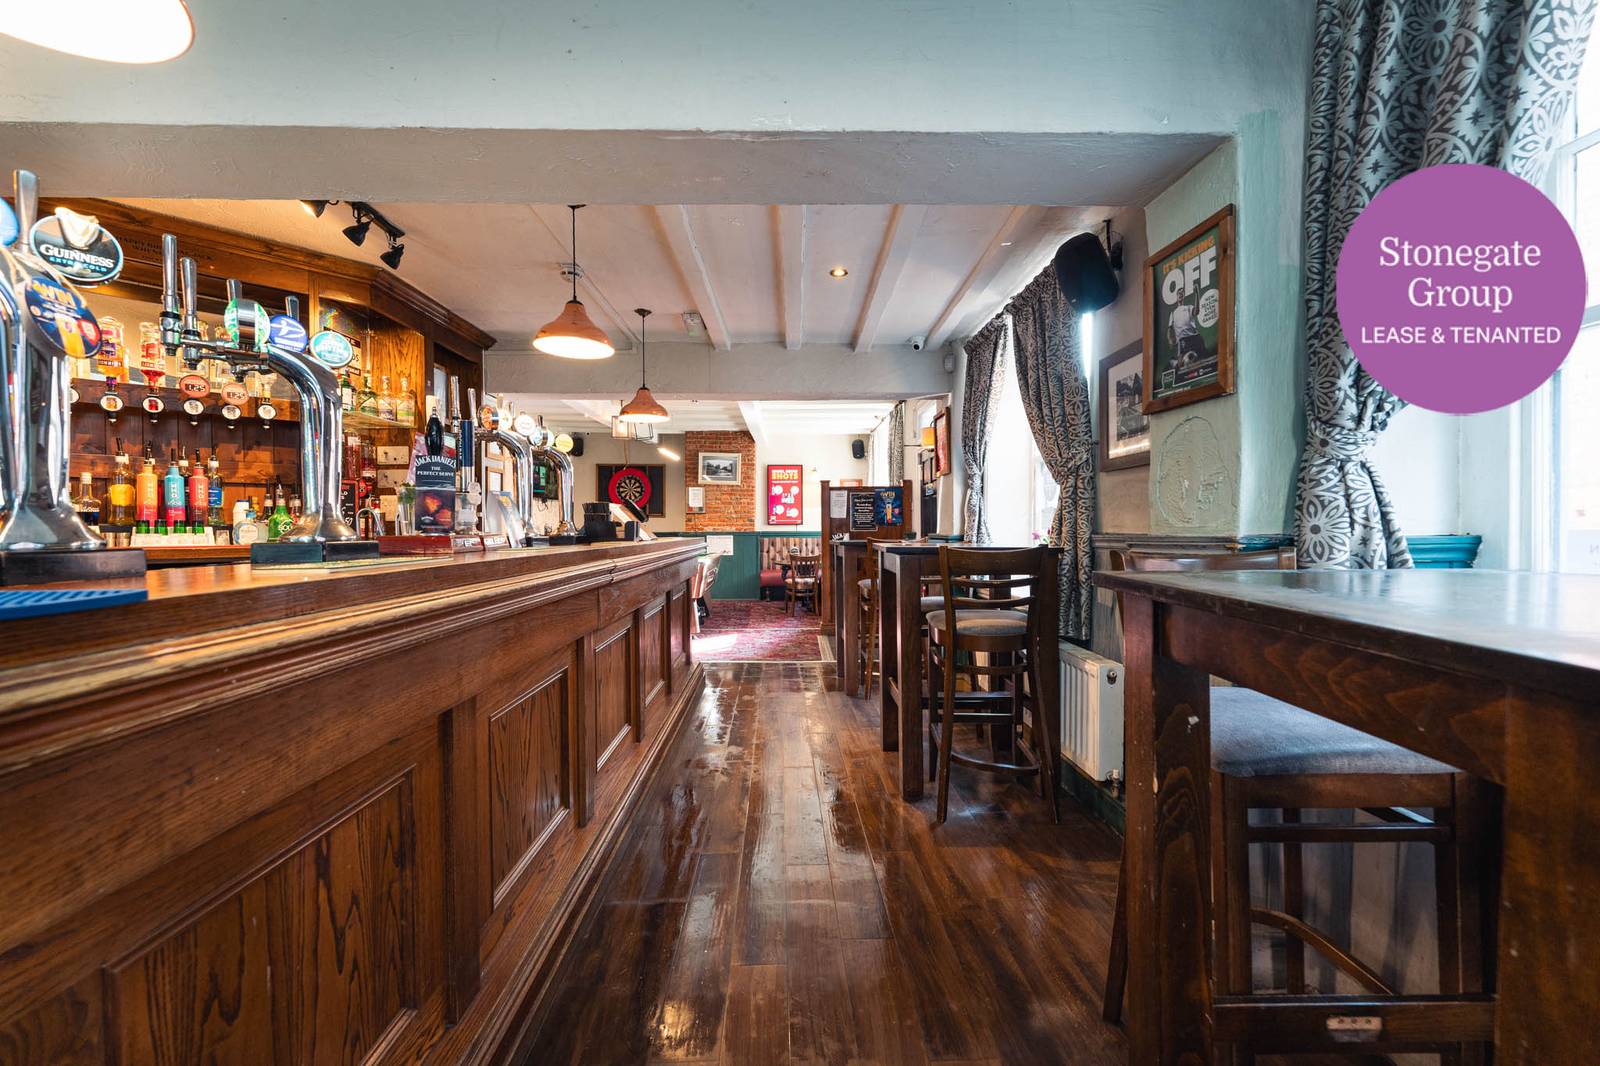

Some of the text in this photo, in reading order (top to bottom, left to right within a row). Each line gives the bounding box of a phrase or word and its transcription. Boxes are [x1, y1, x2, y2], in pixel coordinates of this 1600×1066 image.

[40, 243, 115, 268] GUINNESS
[83, 262, 108, 273] COLD
[1162, 245, 1217, 305] OFF
[415, 455, 457, 469] JACK DANIEL'S
[771, 472, 798, 480] SHOTS
